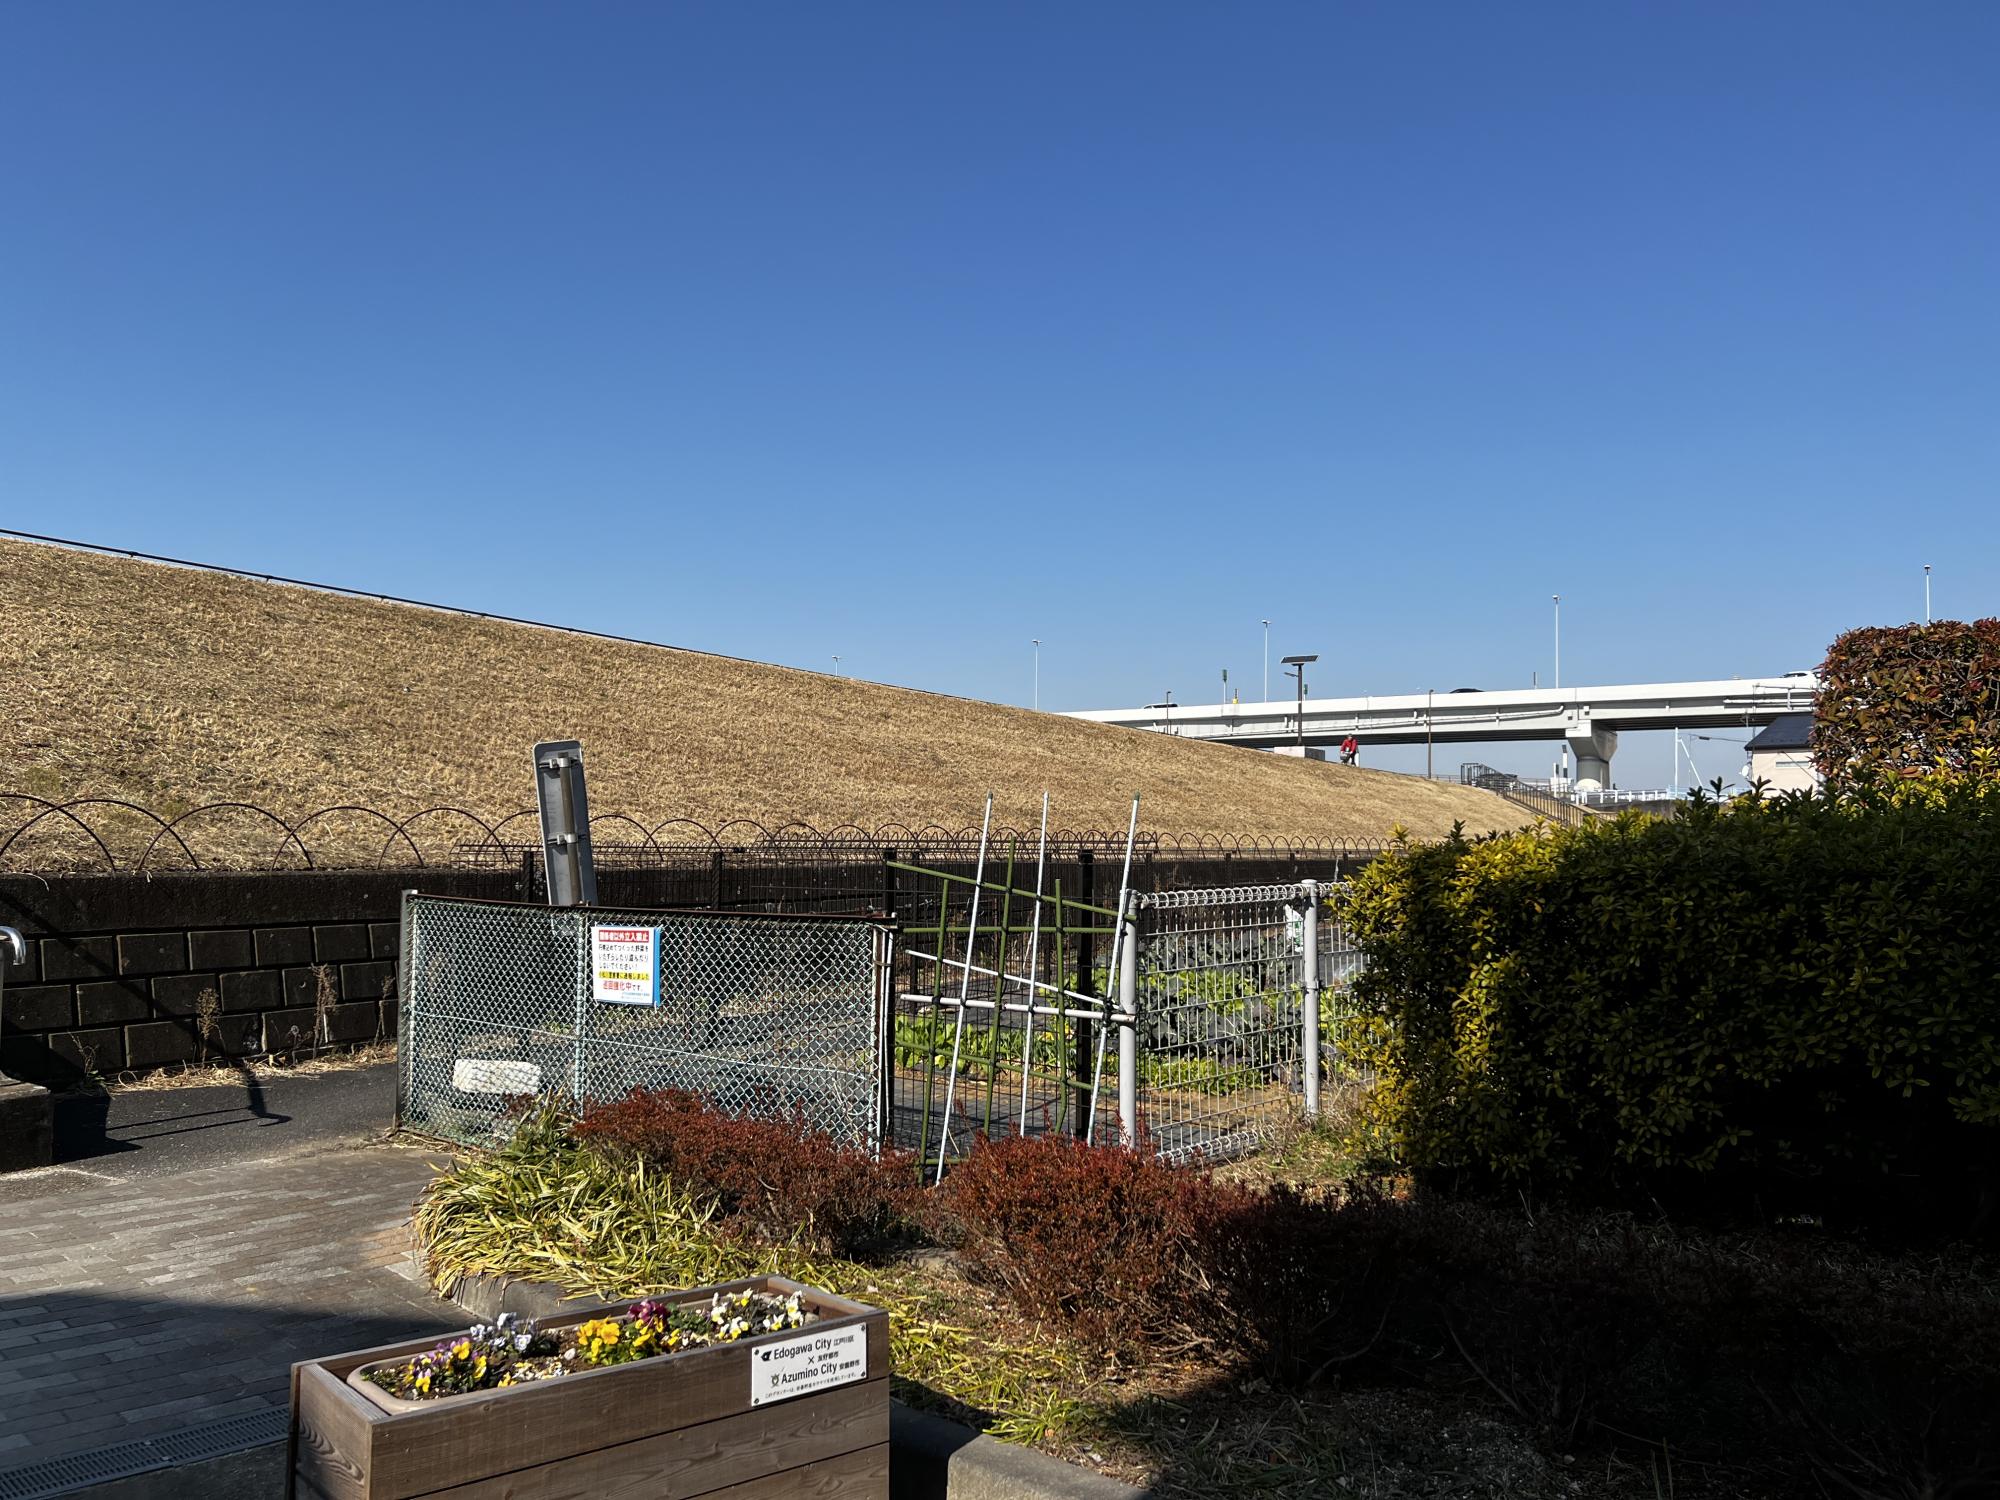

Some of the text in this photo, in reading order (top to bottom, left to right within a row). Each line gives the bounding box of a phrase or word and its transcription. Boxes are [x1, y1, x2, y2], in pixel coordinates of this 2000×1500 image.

[774, 1334, 855, 1360] Edogawa City 江戸川区
[781, 1359, 860, 1384] Azumino City 安曇野市
